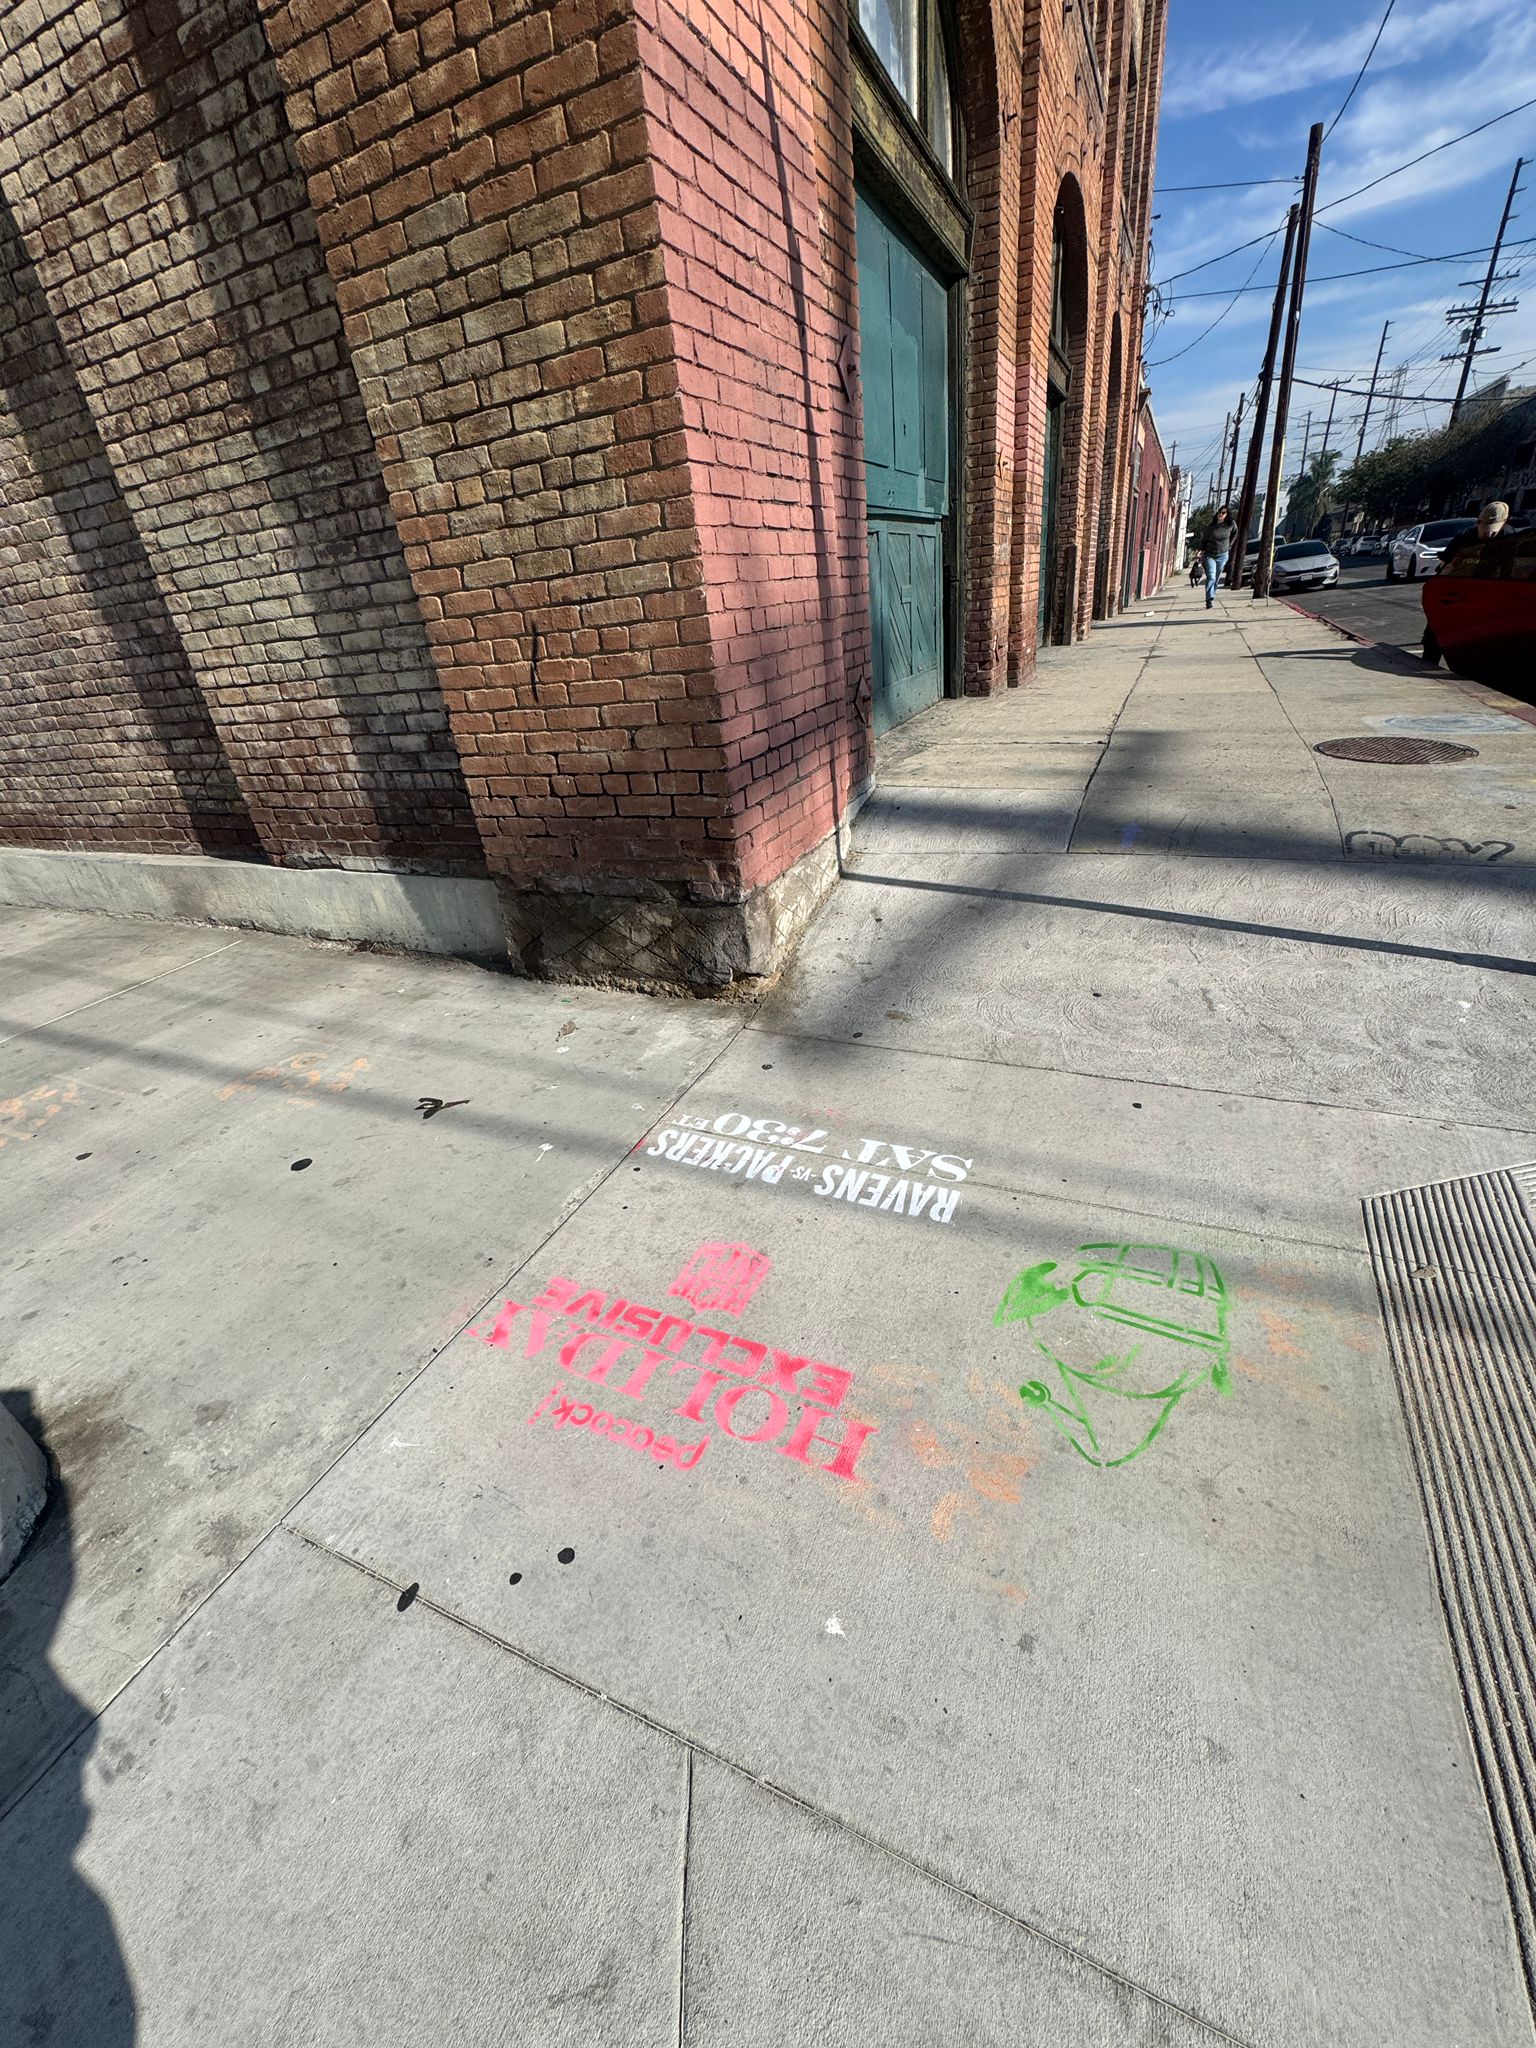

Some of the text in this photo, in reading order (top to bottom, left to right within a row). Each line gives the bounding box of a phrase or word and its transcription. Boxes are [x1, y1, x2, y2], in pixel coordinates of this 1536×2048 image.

[648, 1129, 793, 1184] PACKERS
[670, 1112, 973, 1182] SAT 7:30 ET
[814, 1165, 961, 1223] RAVENS
[531, 1276, 854, 1409] EXCLUSIVE
[462, 1299, 879, 1483] HOLIDAY
